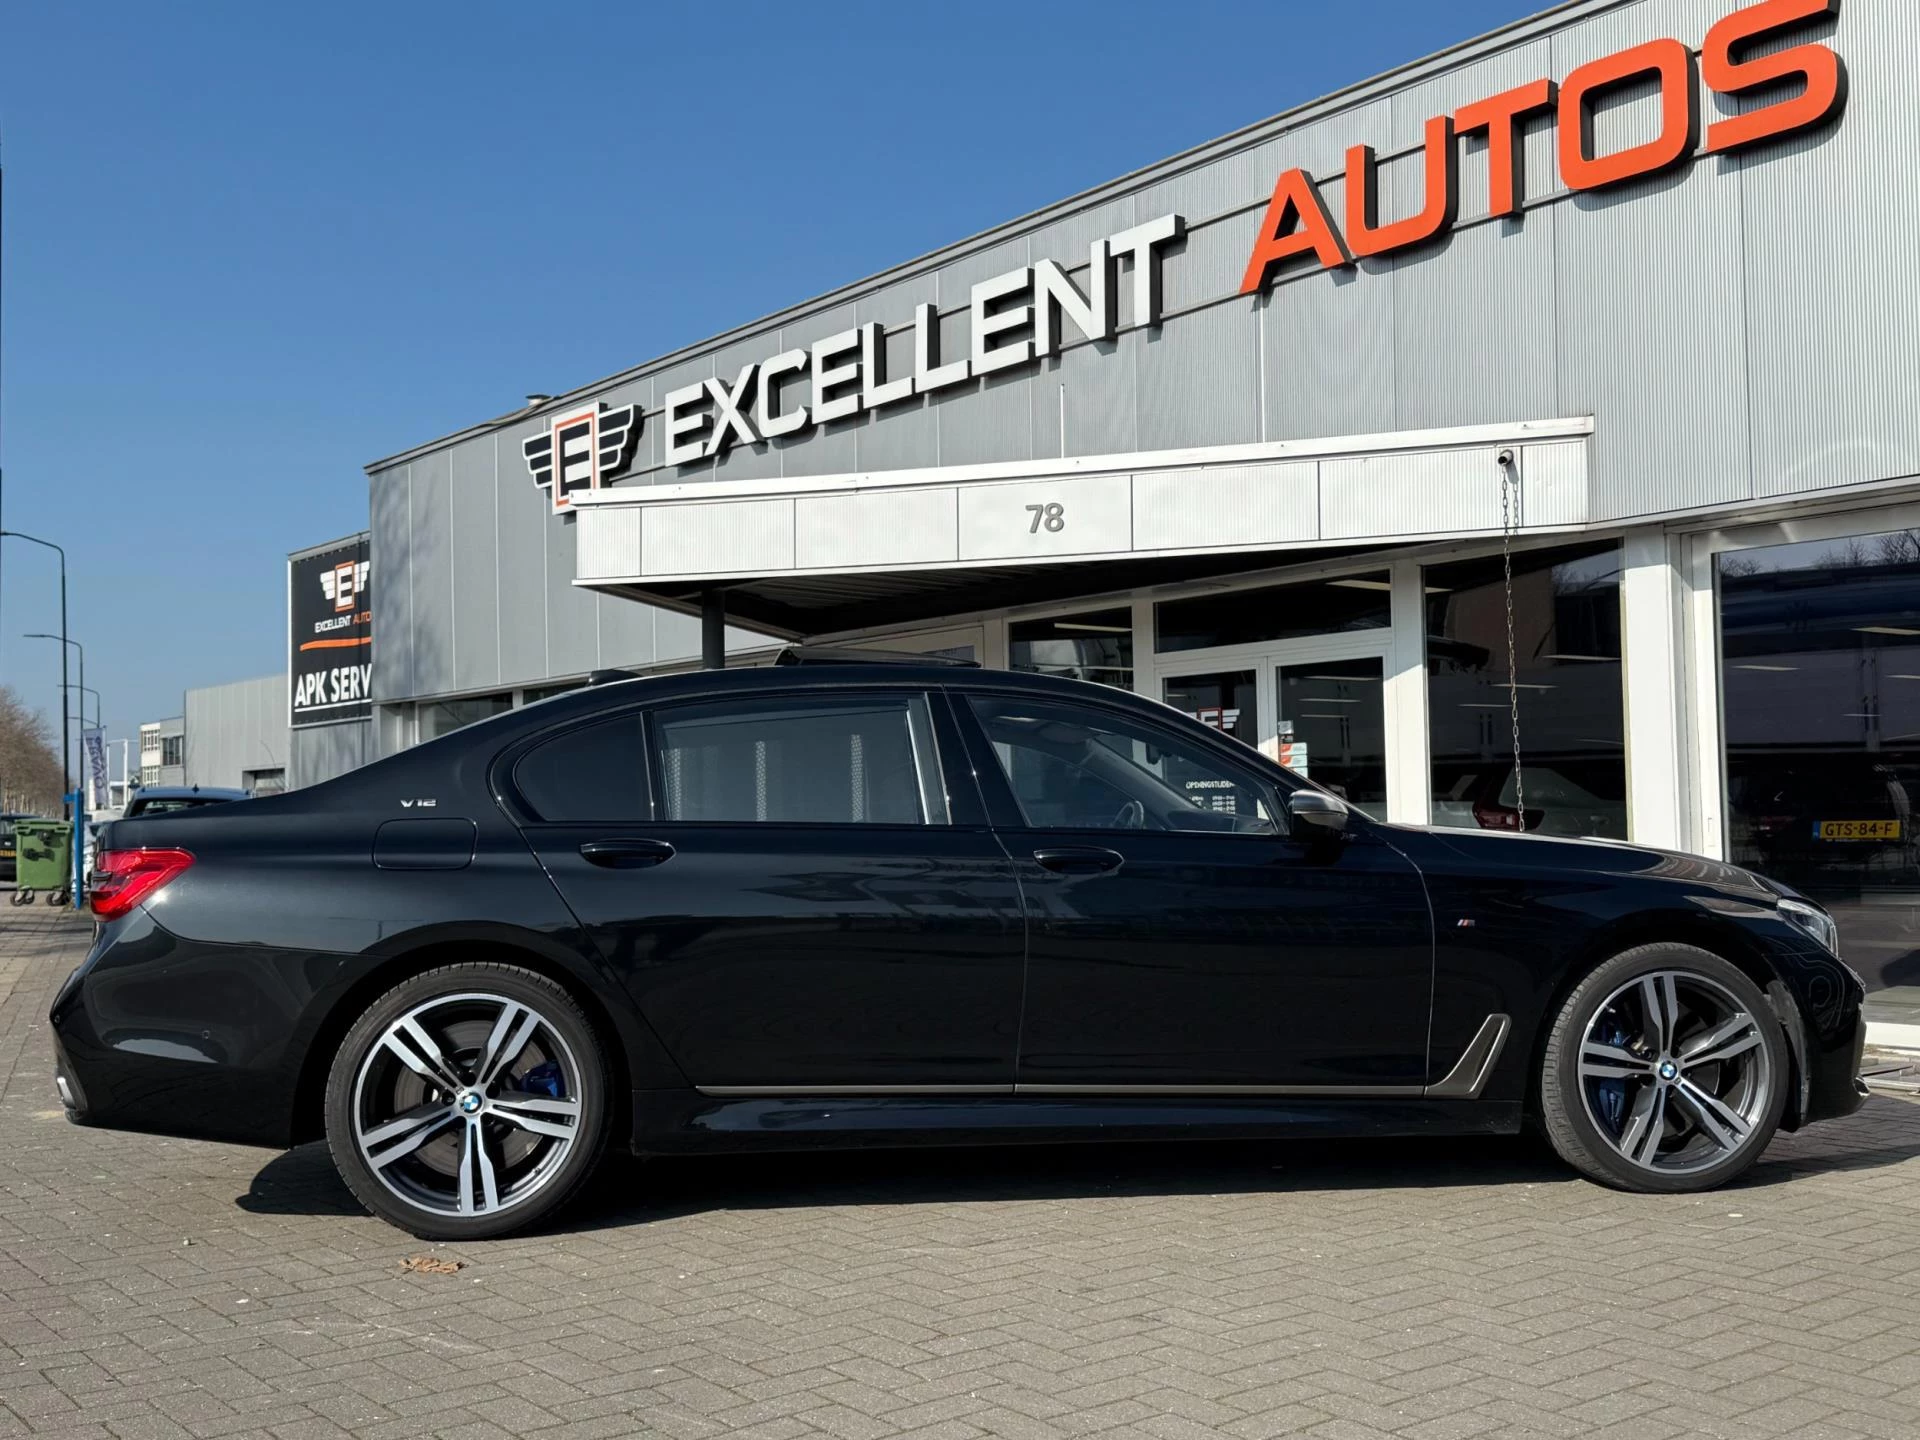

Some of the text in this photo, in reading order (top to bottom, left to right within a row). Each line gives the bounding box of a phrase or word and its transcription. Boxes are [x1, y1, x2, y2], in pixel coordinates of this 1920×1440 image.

[665, 0, 1848, 467] EXCELLENT AUTOS
[1025, 502, 1065, 534] 78
[314, 614, 351, 633] EXCELLENT
[294, 663, 373, 708] APK SERV
[400, 798, 437, 808] V12
[1824, 823, 1893, 837] GTS-84-F
